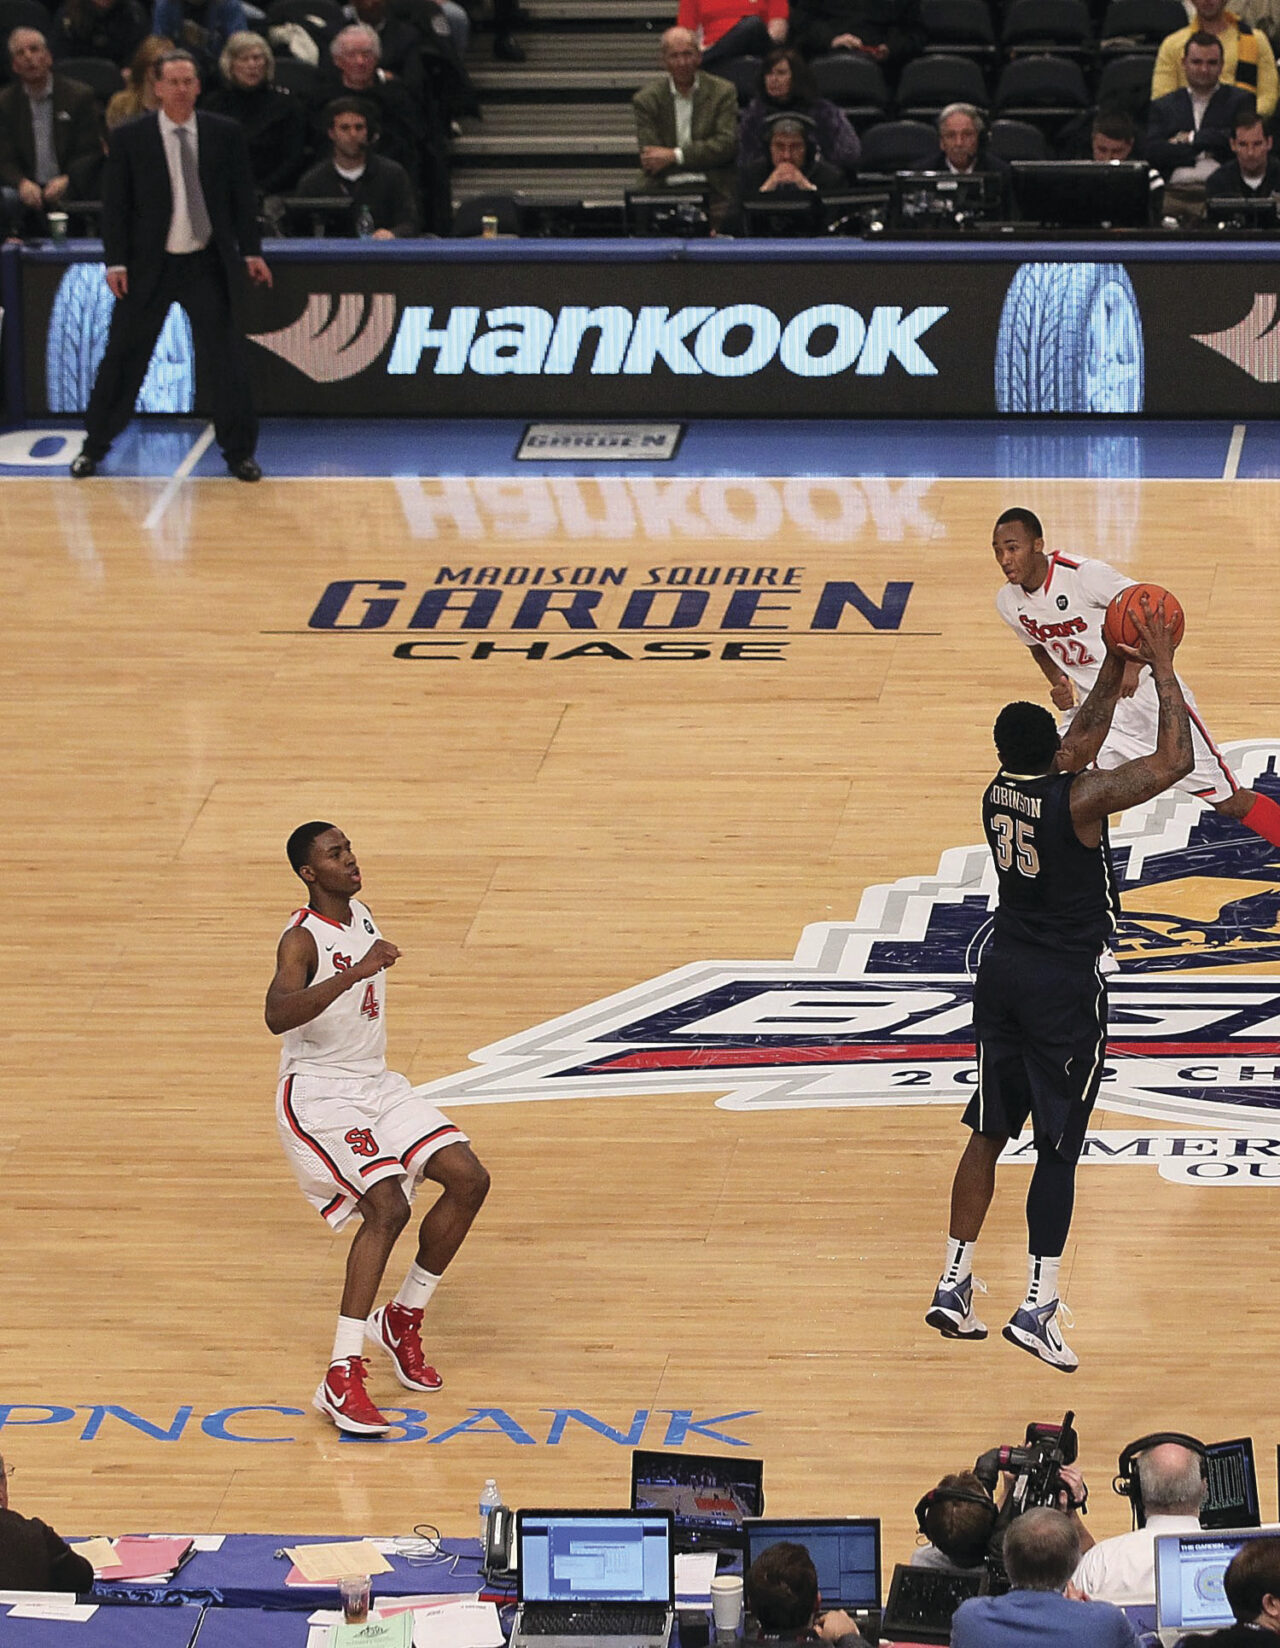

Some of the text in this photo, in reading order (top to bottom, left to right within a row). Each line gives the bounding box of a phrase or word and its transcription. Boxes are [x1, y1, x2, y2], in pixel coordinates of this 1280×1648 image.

[434, 567, 806, 586] MADISON SQUARE
[307, 579, 914, 630] GARDEN
[392, 640, 792, 661] CHASE
[1051, 640, 1098, 667] 22
[990, 784, 1043, 819] OBINSON
[990, 813, 1040, 879] 35
[360, 981, 380, 1021] 4
[0, 1404, 763, 1446] PNC BANK
